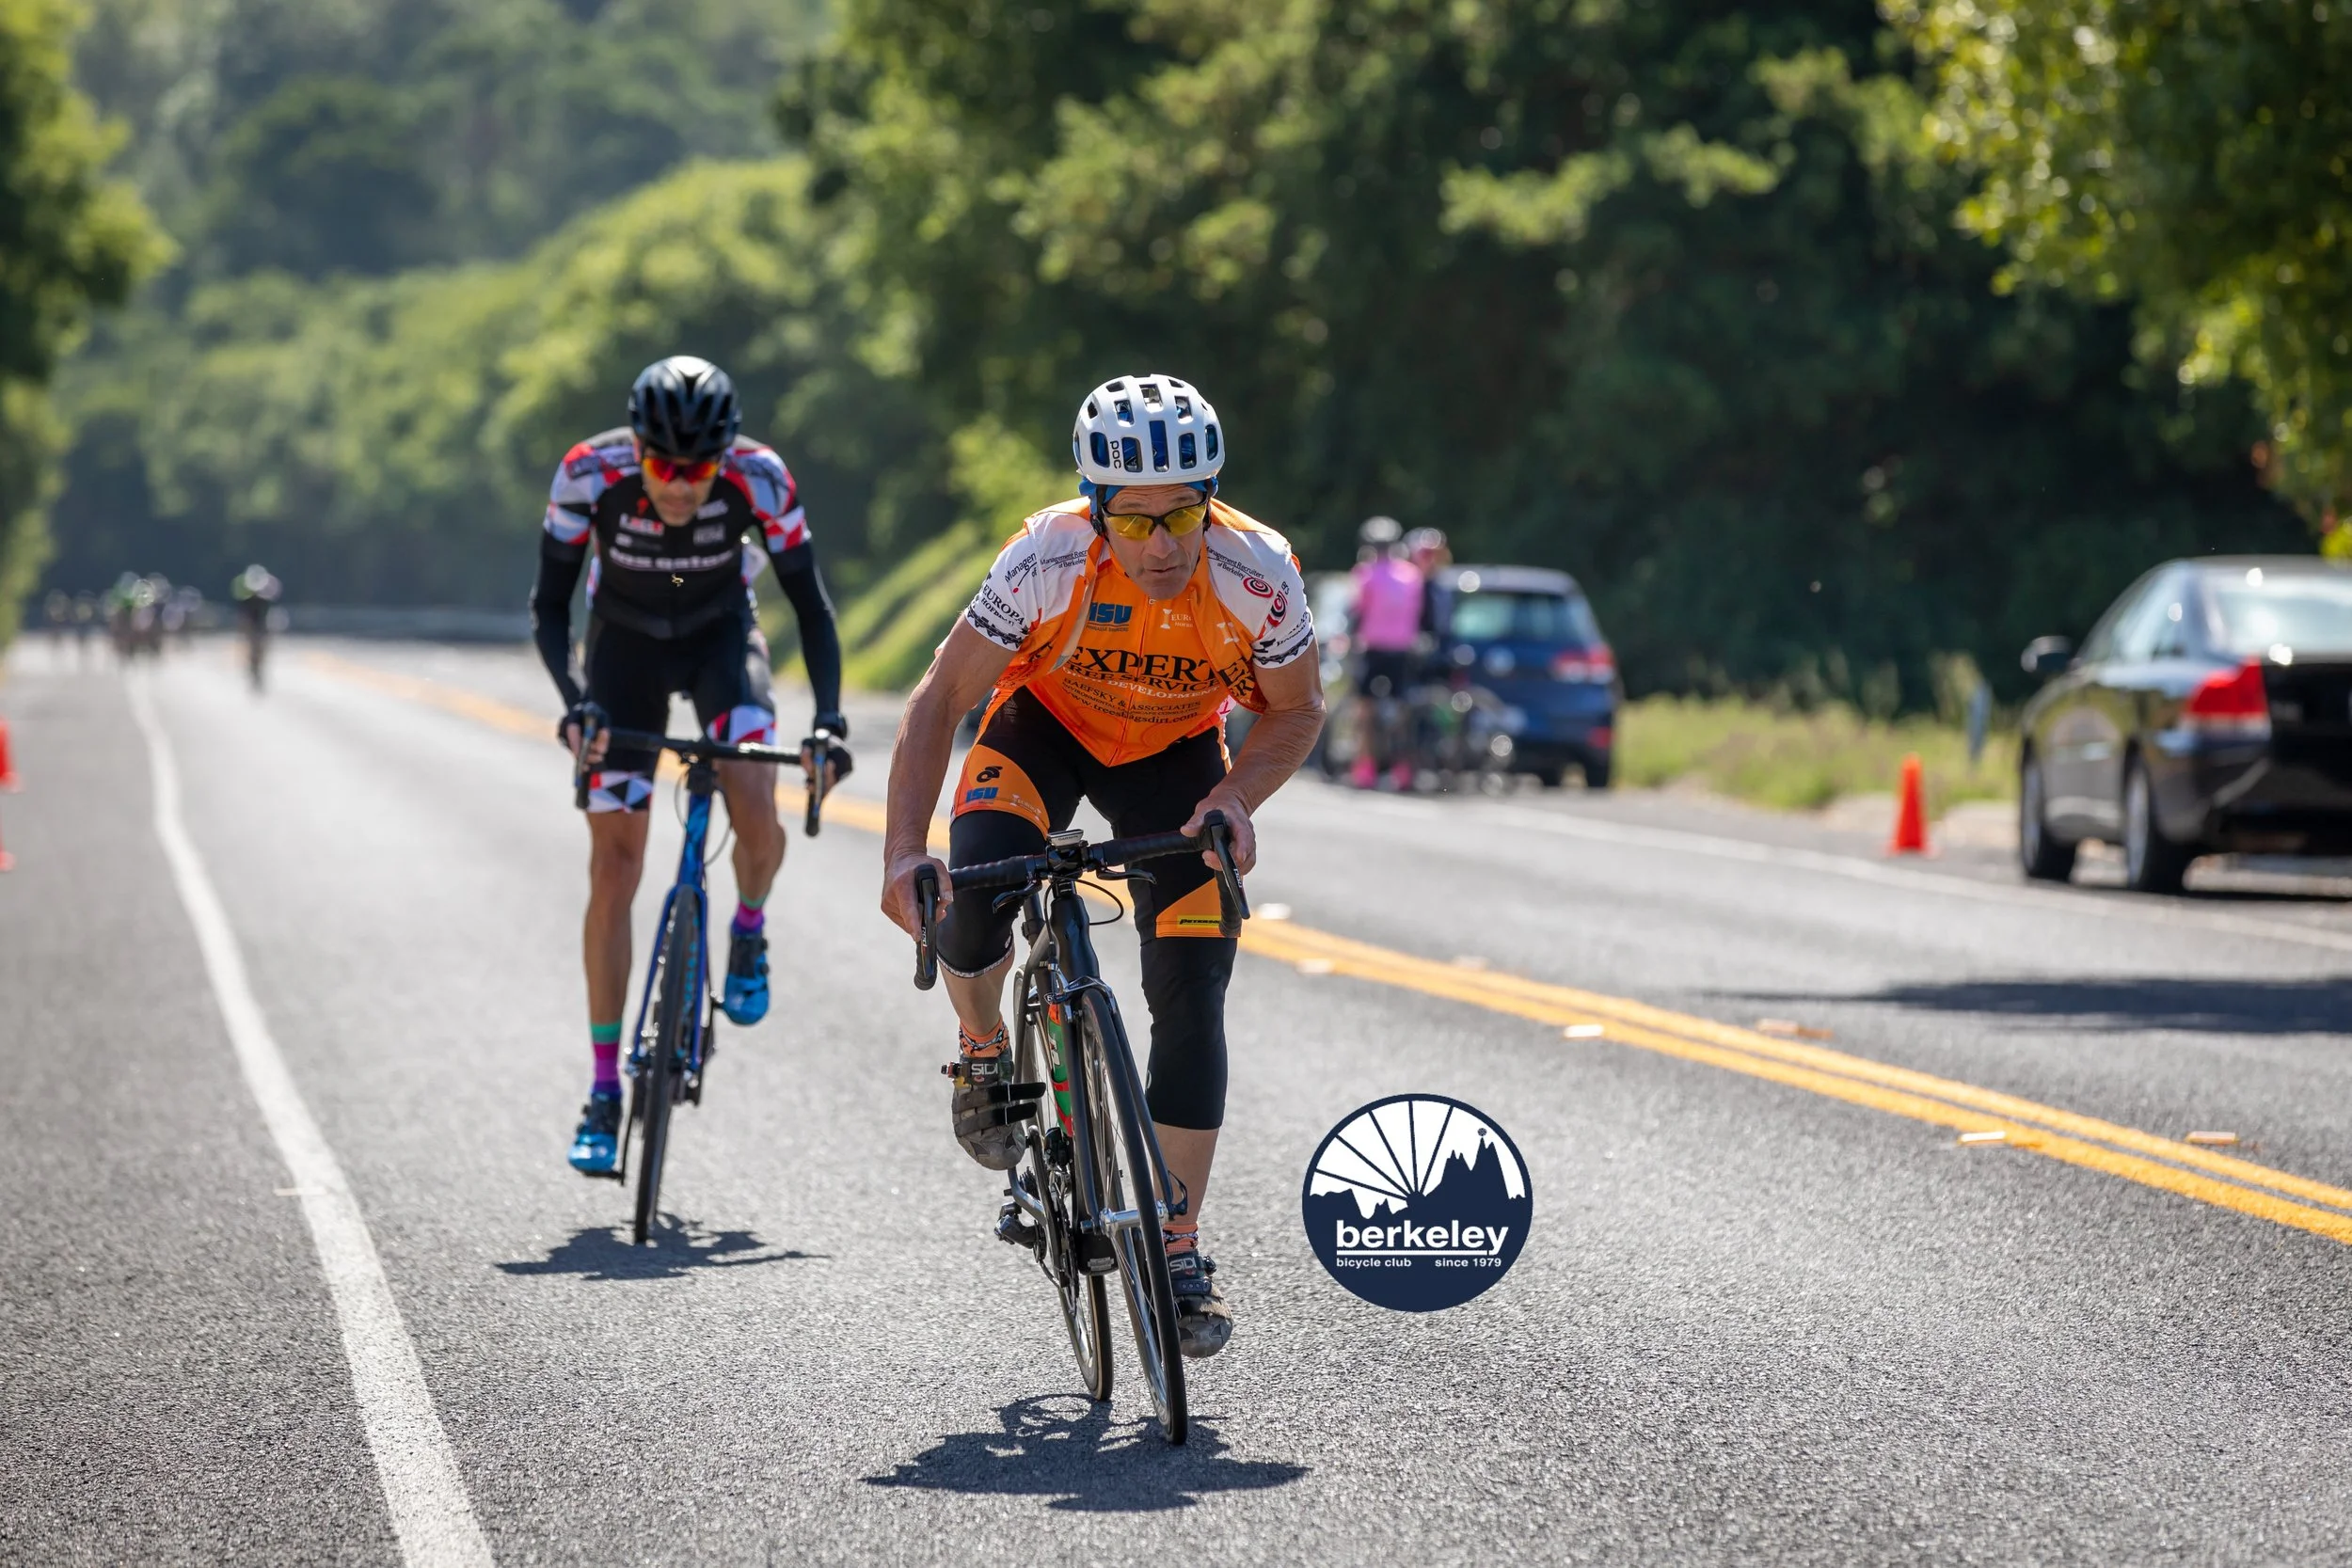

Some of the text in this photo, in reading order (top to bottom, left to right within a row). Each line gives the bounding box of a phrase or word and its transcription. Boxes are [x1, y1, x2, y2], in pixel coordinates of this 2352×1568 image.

[1040, 552, 1074, 565] Management
[1063, 558, 1087, 568] Berkeley
[1222, 563, 1247, 580] Berkeley
[1237, 562, 1265, 579] Recruiters
[982, 584, 1025, 626] EUROPA
[1106, 680, 1220, 699] DEVELOPMENT
[971, 1063, 998, 1075] SIDI
[1169, 1258, 1197, 1273] SIDI
